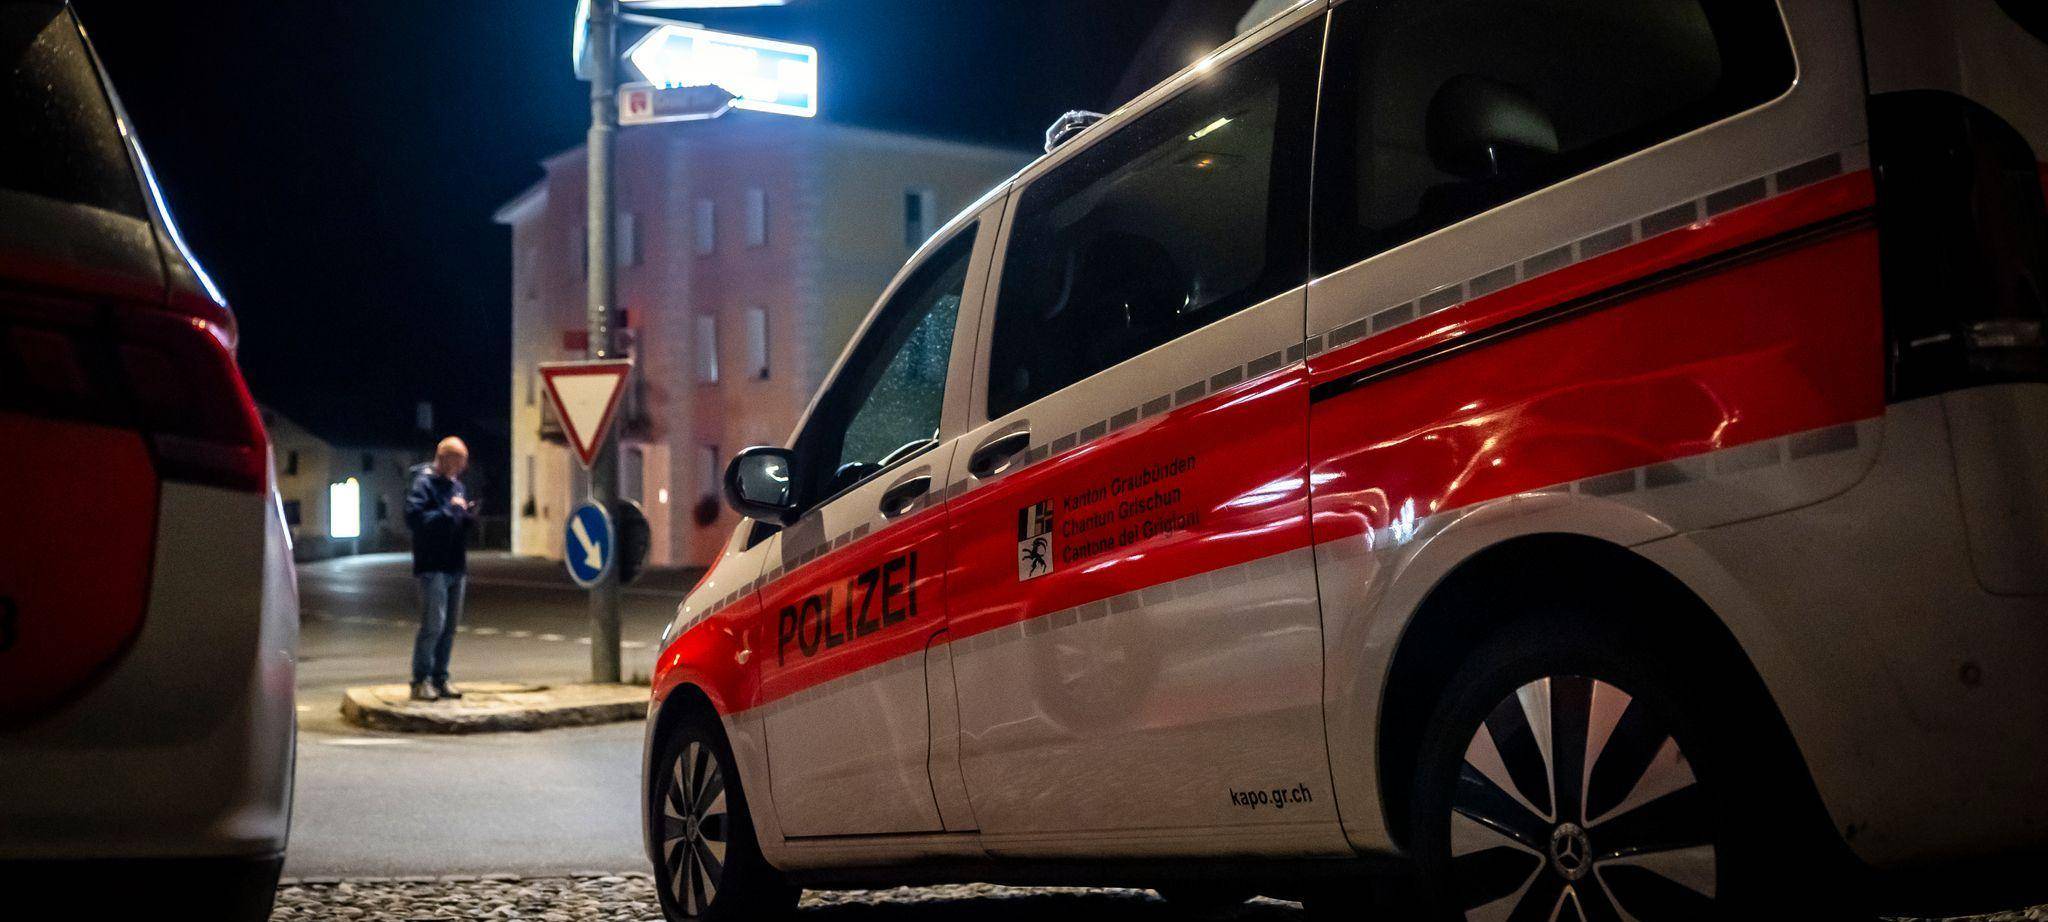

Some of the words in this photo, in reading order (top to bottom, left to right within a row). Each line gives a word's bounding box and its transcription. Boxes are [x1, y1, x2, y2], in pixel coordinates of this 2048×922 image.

[1063, 484, 1107, 511] Kanton
[1110, 454, 1197, 496] Graubünden
[1062, 511, 1115, 538] Chantun
[1118, 487, 1182, 519] Grischun
[1062, 537, 1115, 563] Cantone
[1118, 525, 1139, 547] dei
[1142, 509, 1200, 540] Grigioni
[778, 551, 918, 668] POLIZEI
[1229, 783, 1313, 810] kapo.gr.ch
